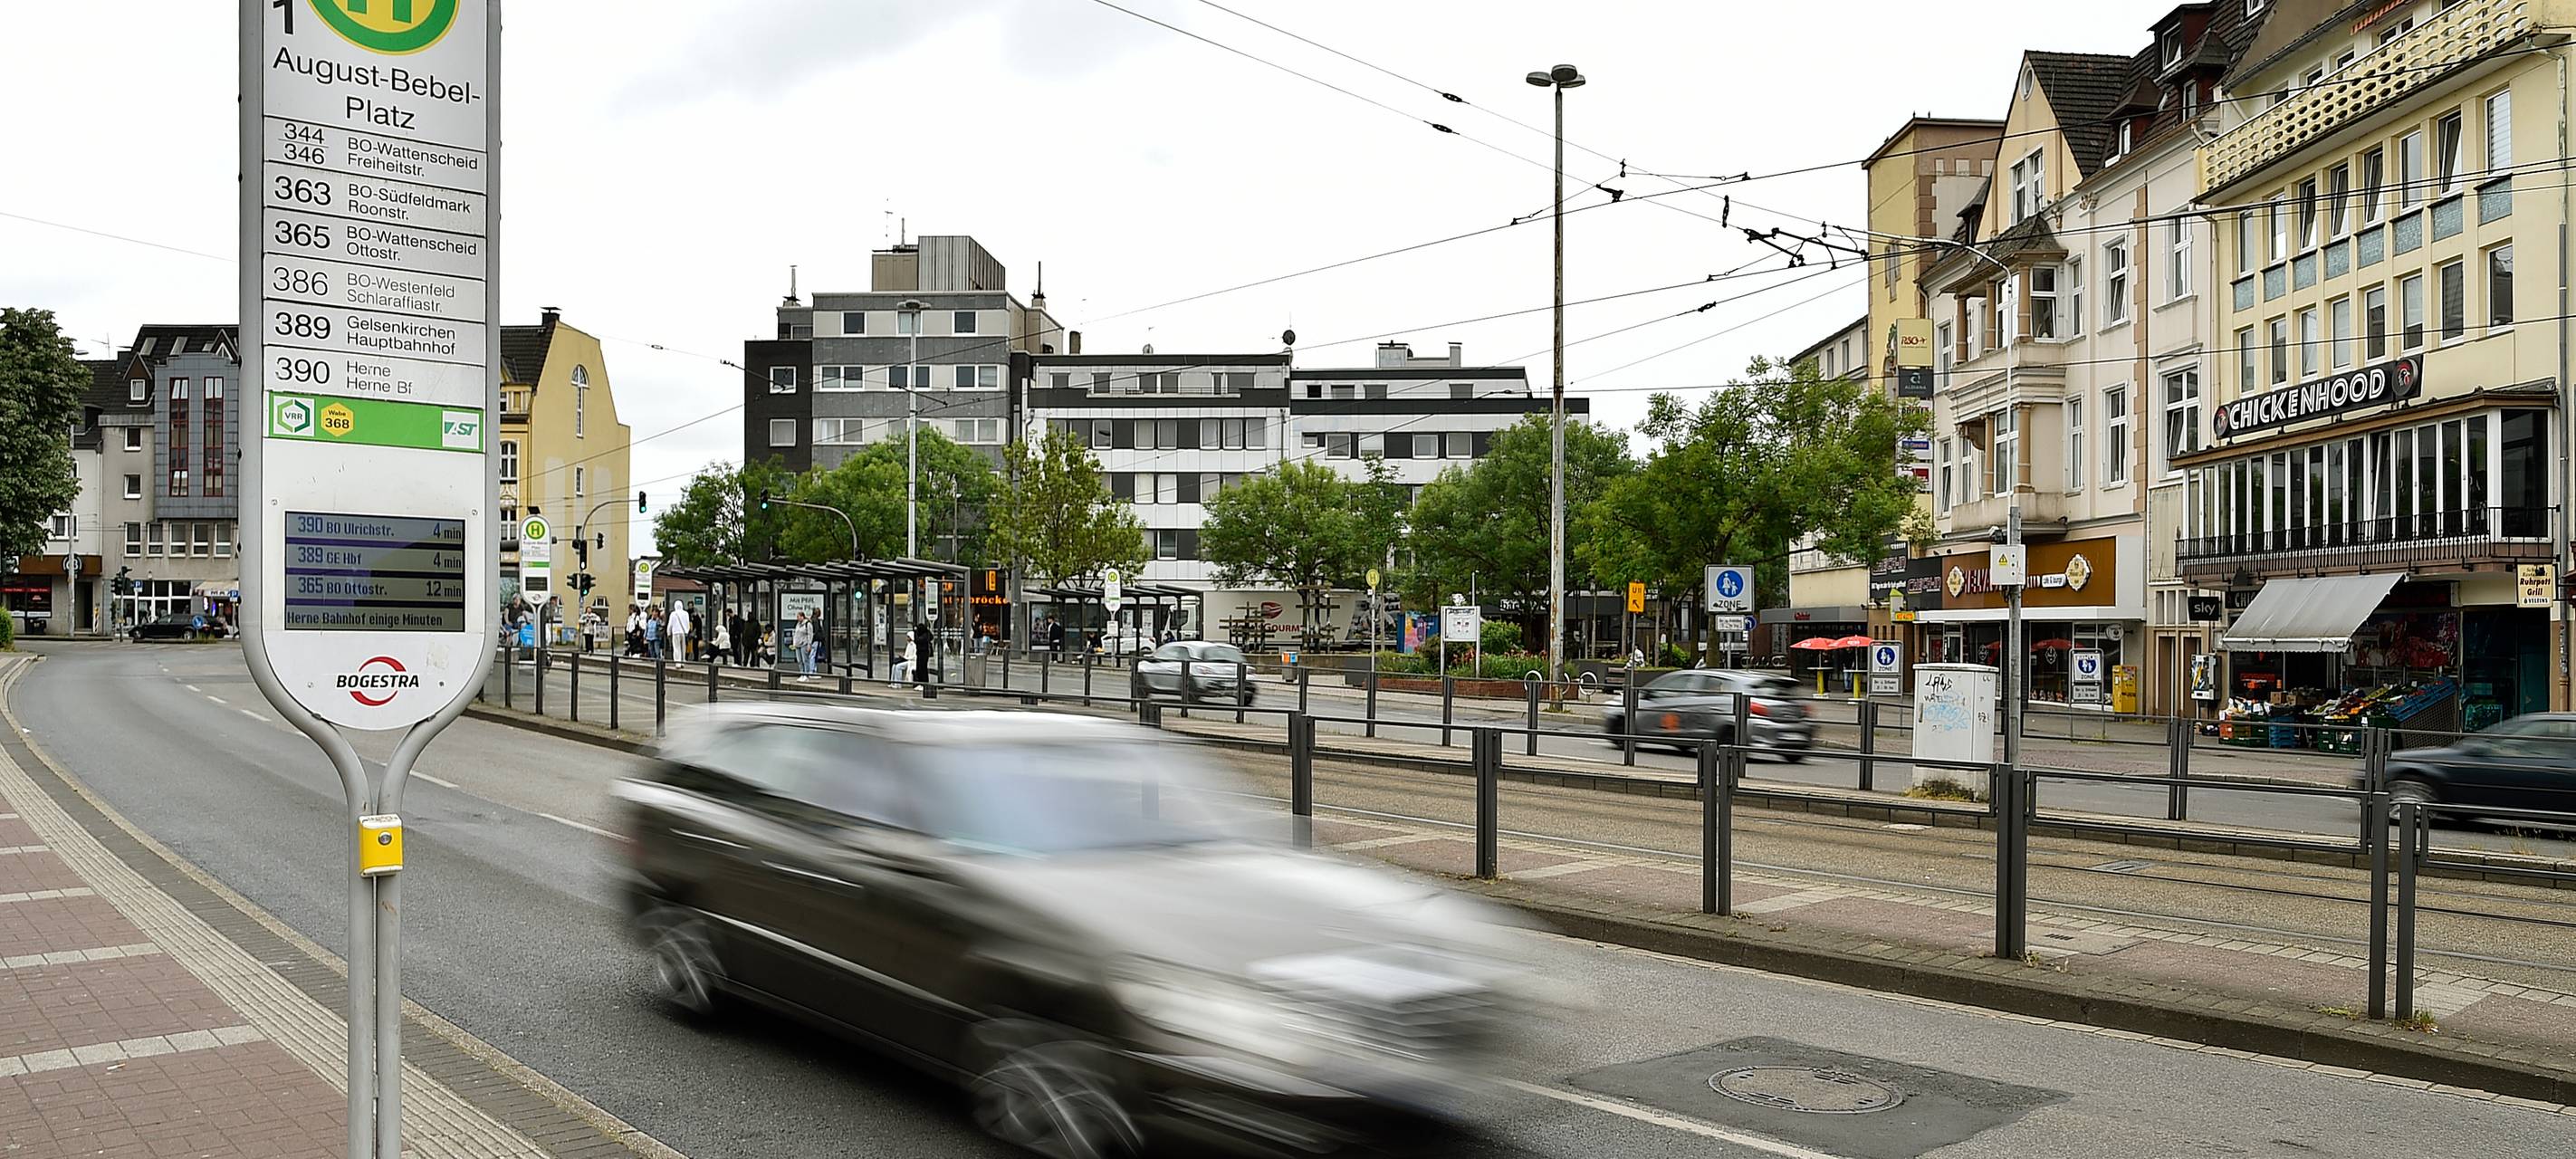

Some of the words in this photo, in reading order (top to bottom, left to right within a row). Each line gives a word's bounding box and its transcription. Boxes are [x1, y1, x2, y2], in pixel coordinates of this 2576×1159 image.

[273, 46, 481, 104] August-Bebel-
[346, 96, 416, 130] Platz
[284, 122, 325, 145] 344
[284, 143, 325, 165] 346
[348, 137, 478, 170] BO-Wattenscheid
[348, 153, 425, 177] Freiheitstr.
[274, 175, 331, 206] 363
[348, 183, 471, 215] BO-Südfeldmark
[348, 199, 409, 221] Roonstr.
[274, 220, 331, 250] 365
[347, 225, 477, 255] BO-Wattenscheid
[346, 242, 401, 262] Ottostr.
[273, 266, 329, 296] 386
[347, 273, 455, 299] BO-Westenfeld
[346, 290, 443, 313] Schlaraffiastr.
[274, 311, 331, 340] 389
[346, 315, 455, 340] Gelsenkirchen
[347, 332, 455, 355] Hauptbahnhof
[275, 357, 330, 385] 390
[346, 359, 391, 377] Herne
[346, 377, 391, 393] Herne
[397, 380, 413, 395] Bf
[2229, 369, 2386, 430] CHICKENHOOD
[284, 411, 303, 421] VRR
[325, 418, 350, 429] 368
[298, 516, 322, 533] 390
[326, 522, 340, 534] BO
[344, 522, 395, 537] Ulrichstr.
[433, 522, 441, 539] 4
[444, 527, 462, 540] min
[531, 525, 540, 535] H
[298, 547, 323, 563] 389
[326, 552, 340, 564] GE
[343, 552, 361, 565] Hbf
[433, 552, 441, 568] 4
[444, 557, 462, 569] min
[298, 577, 323, 594] 365
[326, 582, 340, 594] BO
[344, 582, 388, 596] Ottostr.
[426, 580, 441, 597] 12
[444, 586, 462, 598] min
[2520, 578, 2551, 587] Ruhrpott
[2527, 588, 2542, 596] Grill
[287, 612, 319, 624] Herne
[322, 612, 366, 625] Bahnhof
[369, 613, 399, 627] einige
[402, 613, 443, 627] Minuten
[2195, 602, 2216, 615] sky
[336, 675, 419, 688] BOGESTRA
